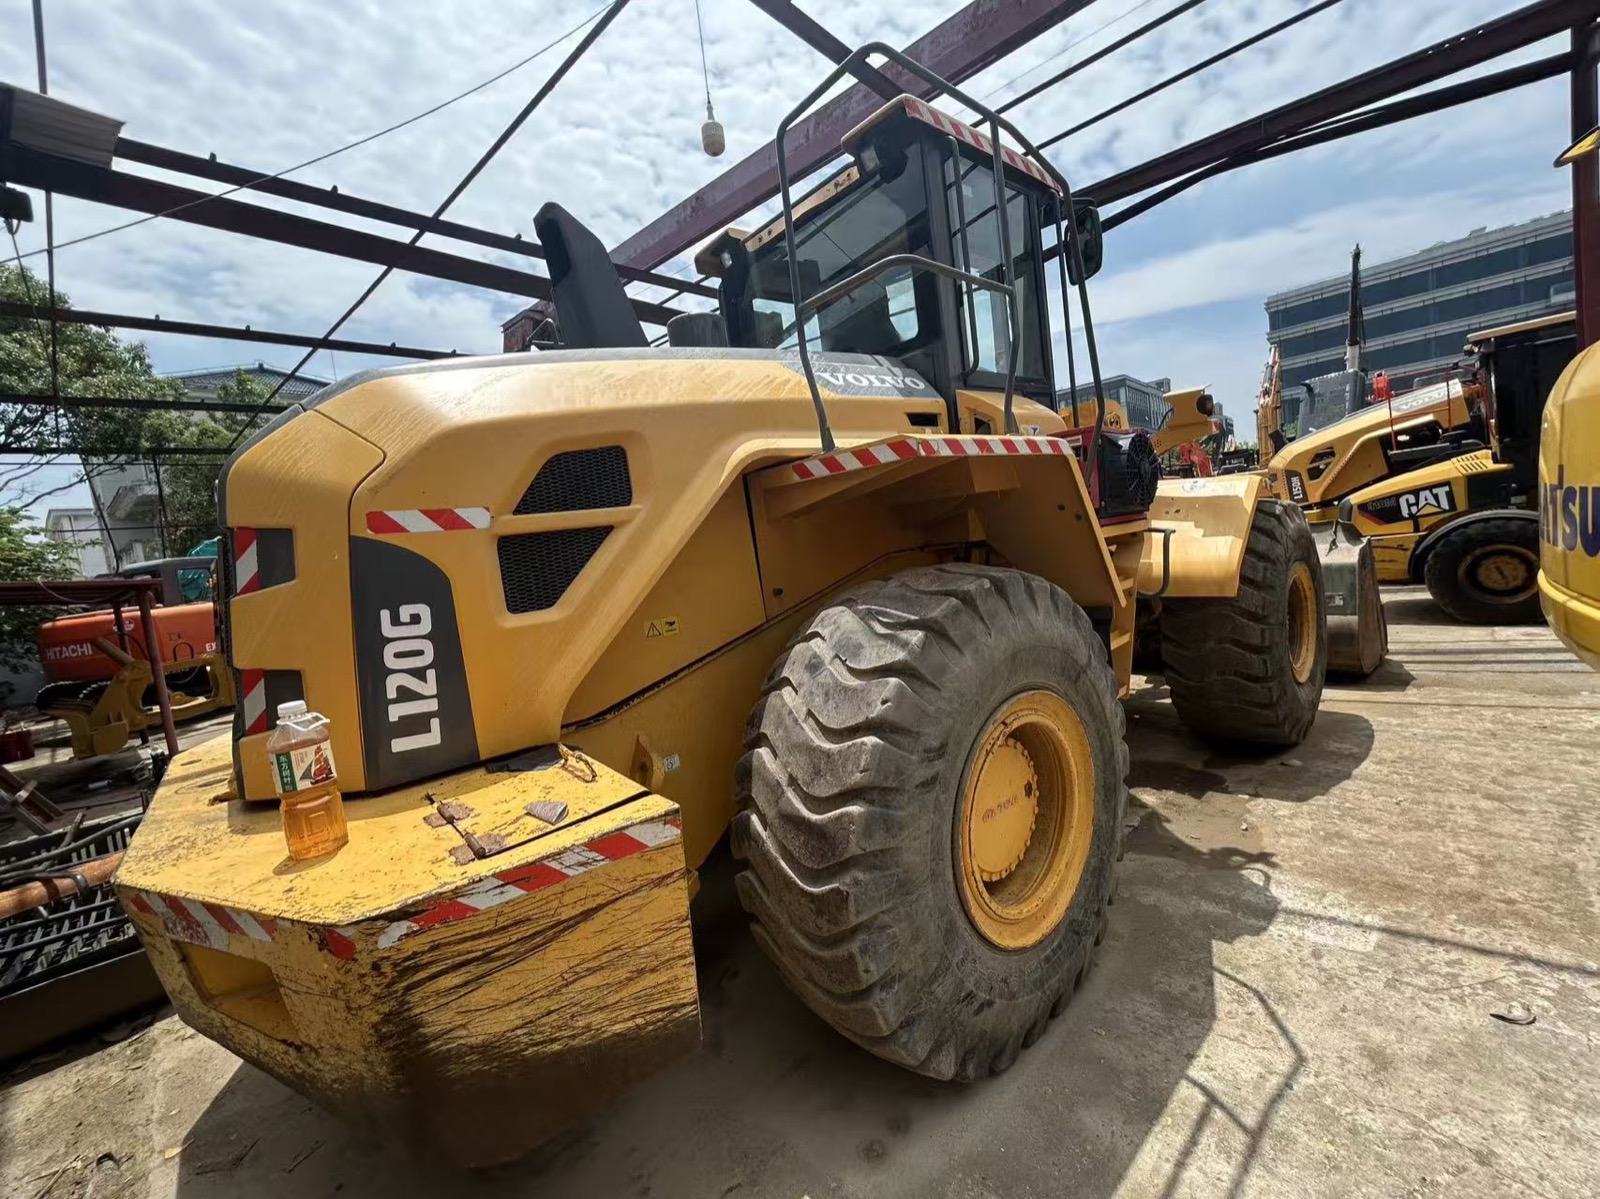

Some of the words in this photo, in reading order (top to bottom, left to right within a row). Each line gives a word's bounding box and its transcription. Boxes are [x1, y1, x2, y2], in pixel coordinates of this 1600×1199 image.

[814, 372, 925, 389] VOLVO
[1291, 476, 1303, 500] L150H
[1399, 485, 1450, 518] CAT
[46, 642, 93, 660] HITACHI
[380, 603, 441, 753] L120G
